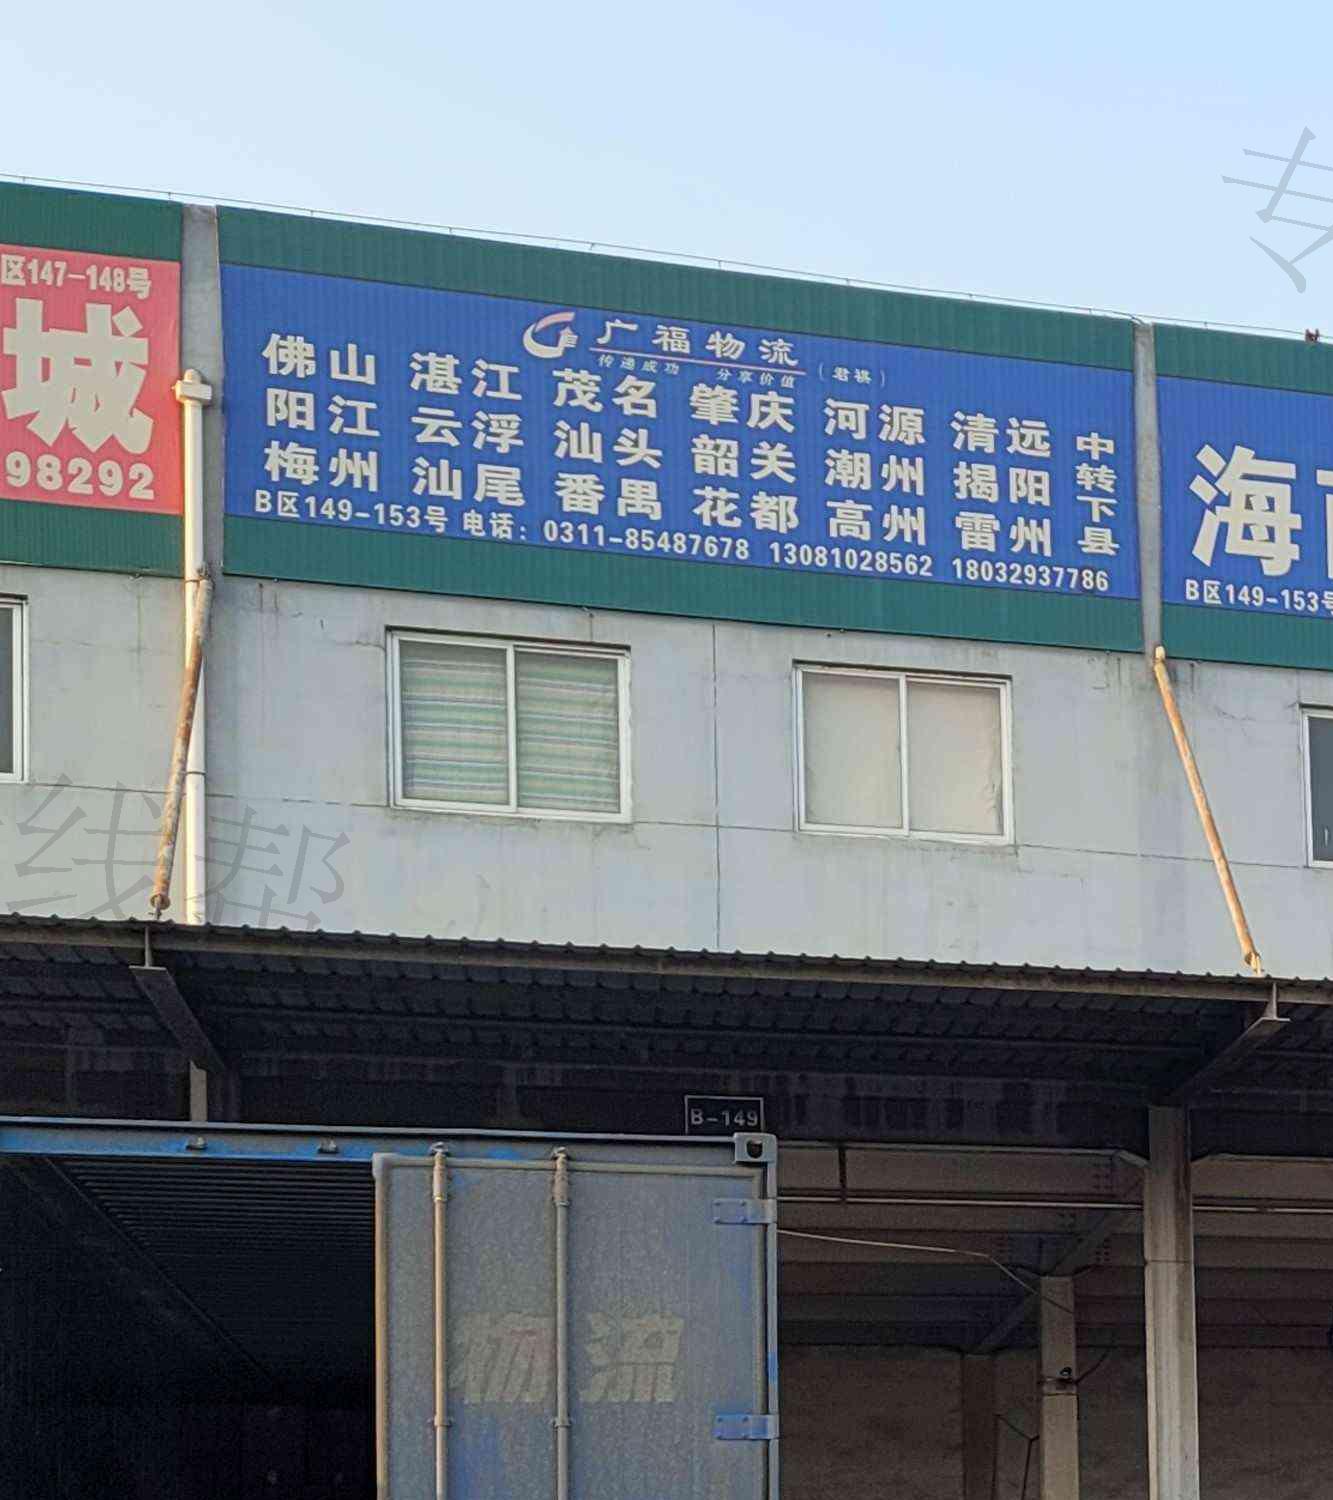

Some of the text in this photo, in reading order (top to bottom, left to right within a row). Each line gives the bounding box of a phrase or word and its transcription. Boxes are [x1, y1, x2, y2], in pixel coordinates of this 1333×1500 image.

[1, 297, 155, 455] 城
[262, 333, 1052, 460] 佛山 湛江 茂名 肇庆 河源 清远
[597, 318, 800, 367] 广福物流
[5, 450, 155, 500] 98292
[264, 440, 1053, 558] 梅州 汕尾 番禺 花都 高州 雷州
[266, 387, 1052, 507] 阳江 云浮 汕头 韶关 潮州 揭阳
[1076, 431, 1120, 557] 中转下县
[255, 490, 448, 535] B区149-153号
[544, 521, 749, 561] 0311-85487678
[769, 542, 933, 577] 13081028562
[952, 557, 1109, 592] 18032937786
[690, 1107, 758, 1127] B-149
